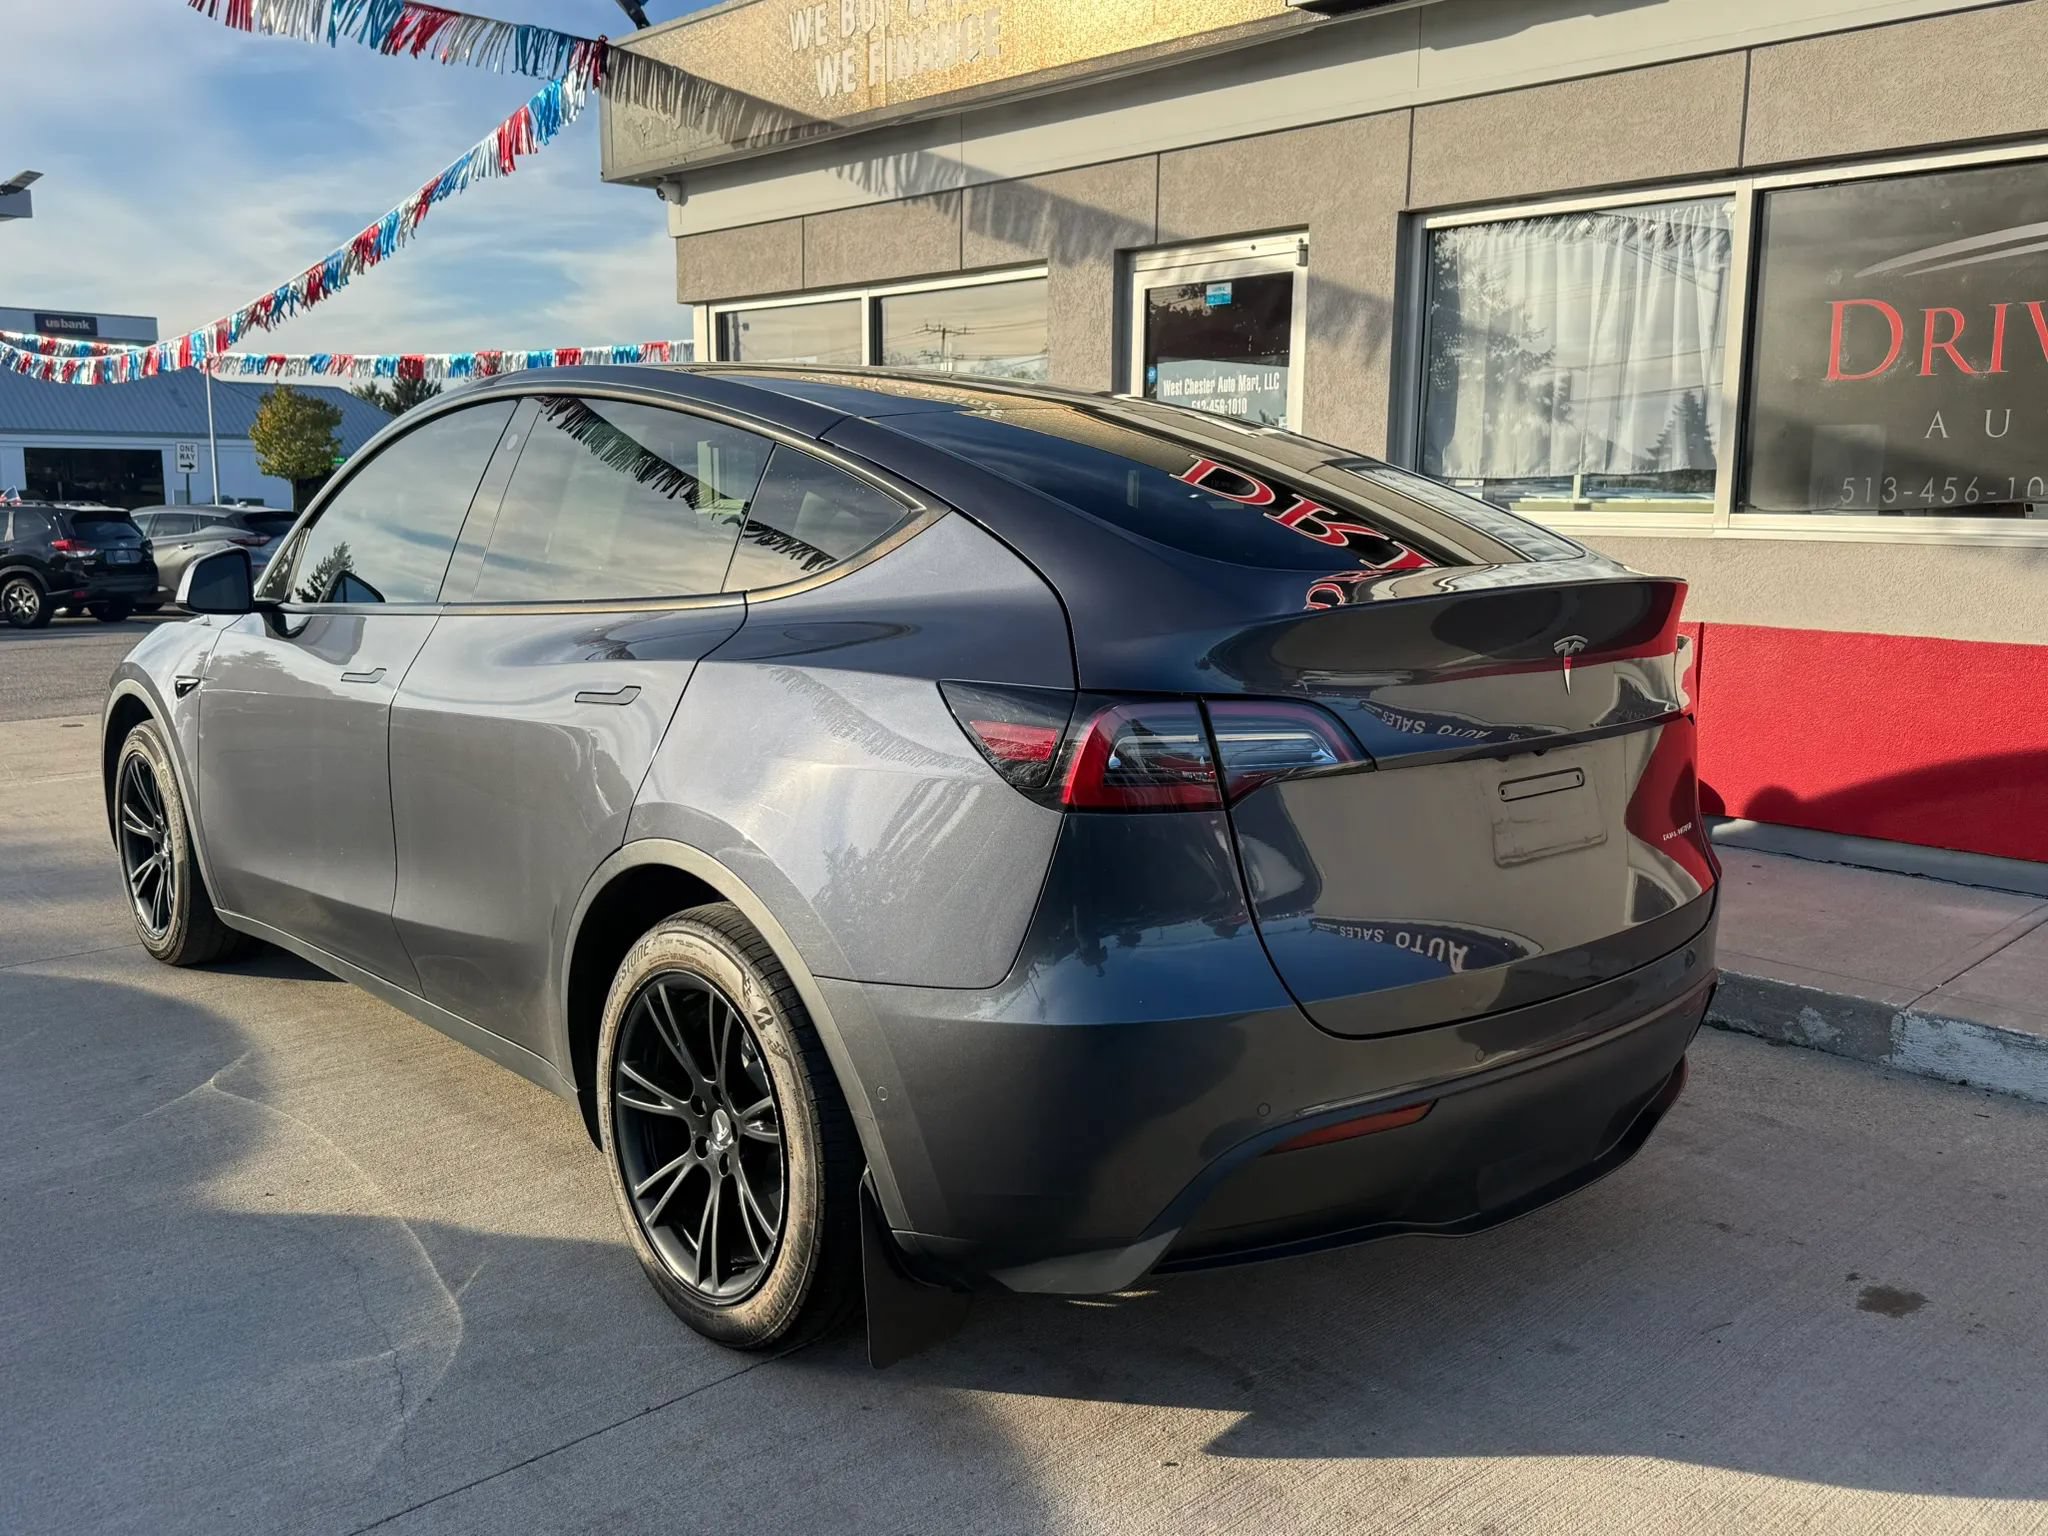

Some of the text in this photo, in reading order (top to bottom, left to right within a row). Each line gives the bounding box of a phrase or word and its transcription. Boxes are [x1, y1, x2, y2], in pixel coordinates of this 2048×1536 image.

[790, 4, 828, 51] WE
[816, 8, 1001, 98] WE FINANCE
[1163, 378, 1182, 397] West
[1184, 376, 1215, 396] Chester
[1217, 376, 1236, 394] Auto
[1264, 372, 1280, 391] LLC
[1339, 926, 1469, 974] AUTO SALES
